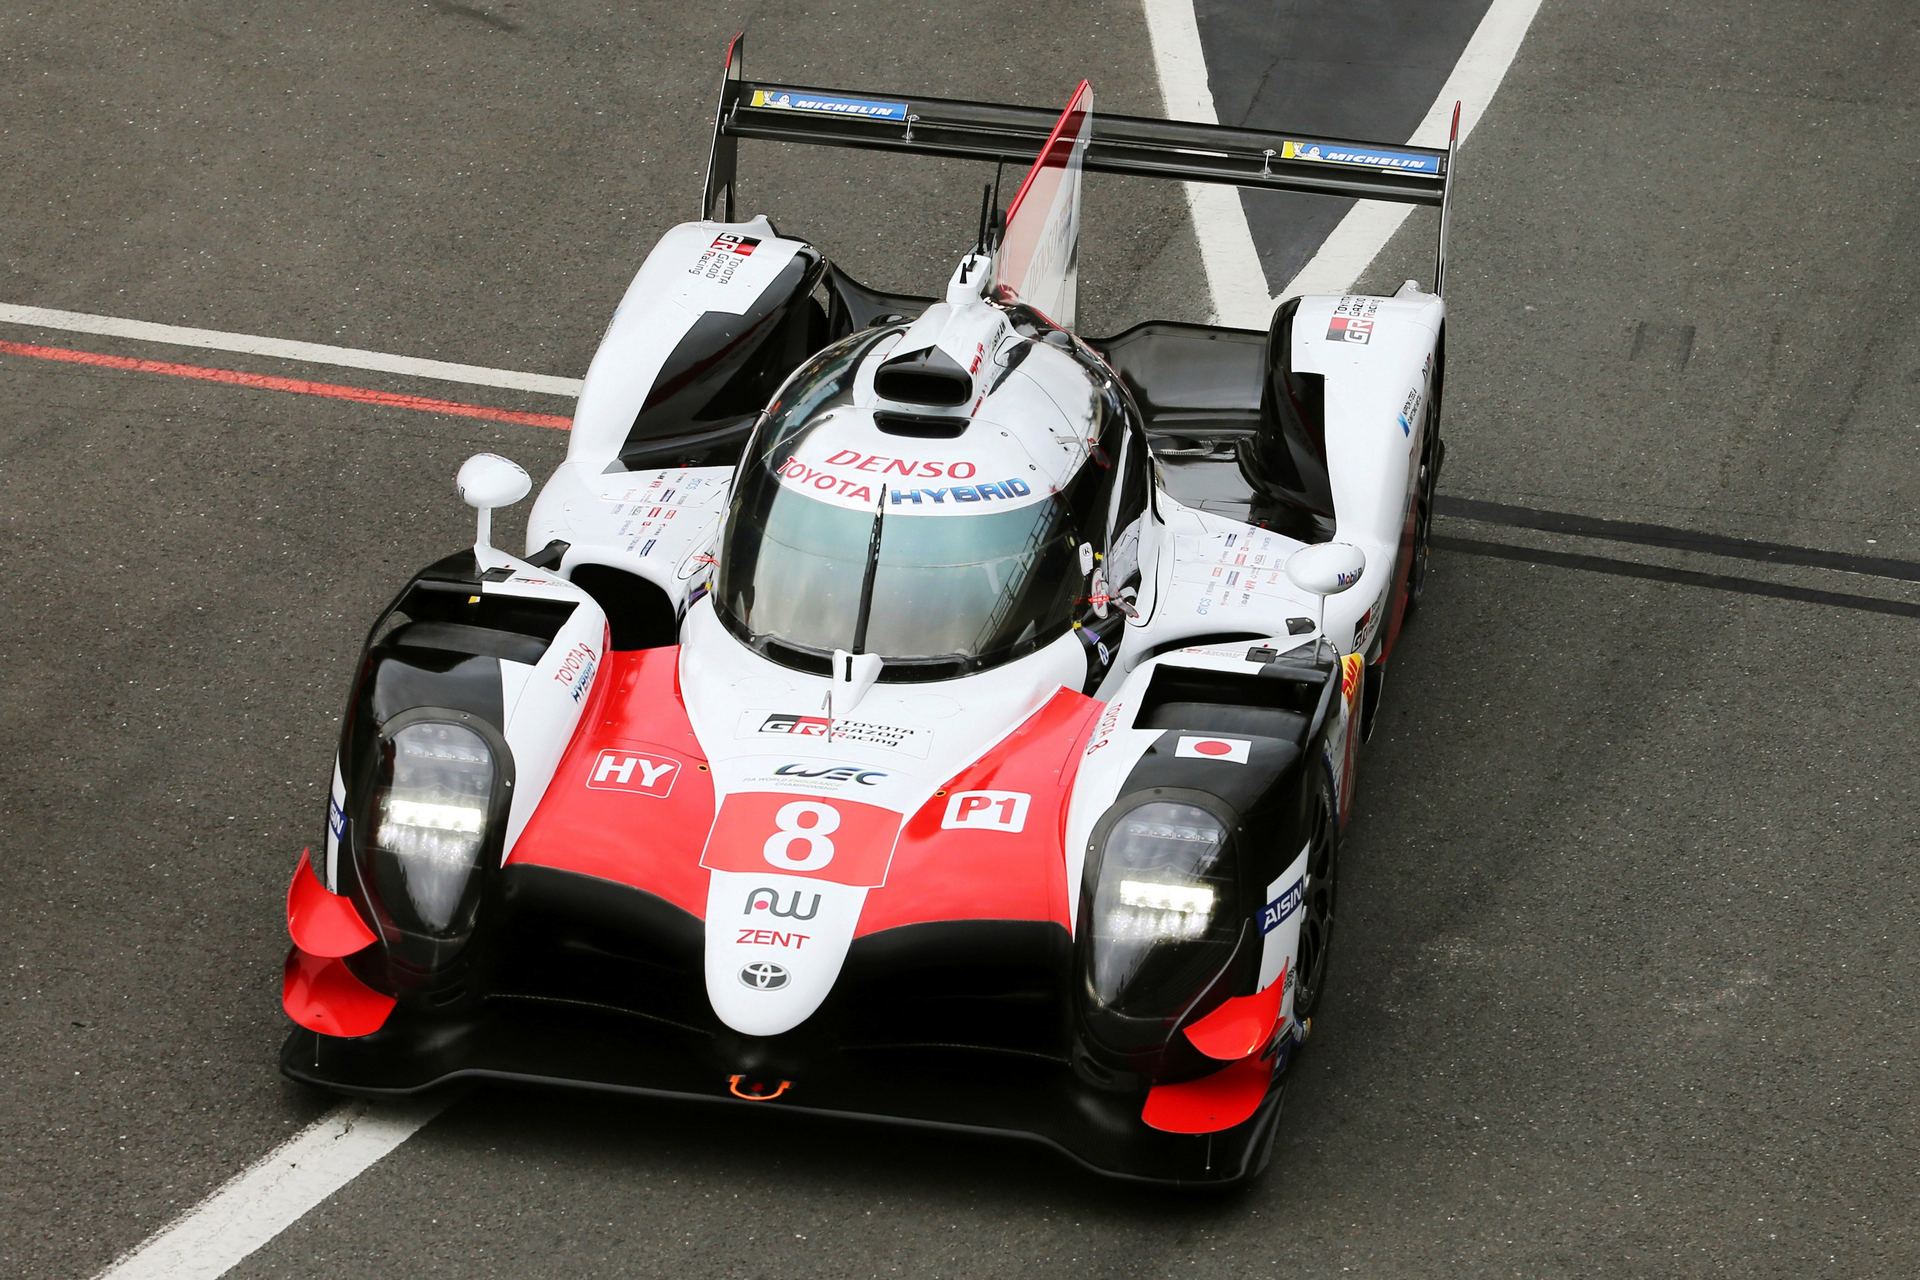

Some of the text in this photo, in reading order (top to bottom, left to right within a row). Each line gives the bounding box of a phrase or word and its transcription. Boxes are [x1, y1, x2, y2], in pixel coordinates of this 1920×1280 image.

[796, 100, 893, 116] MICHELIN
[1327, 152, 1426, 169] MICHELIN
[825, 449, 977, 479] DENSO
[776, 455, 1032, 505] TOYOTA HYBRID
[554, 642, 596, 687] TOYOTA 8
[760, 719, 915, 736] GR TOYOTA
[830, 731, 898, 747] Racing
[834, 726, 904, 740] GAZOO
[1087, 739, 1109, 756] 8
[593, 755, 676, 788] HY
[774, 763, 888, 786] WEC
[955, 796, 1017, 825] P1
[762, 800, 842, 872] 8
[1263, 882, 1303, 930] AISIN
[736, 928, 811, 950] ZENT
